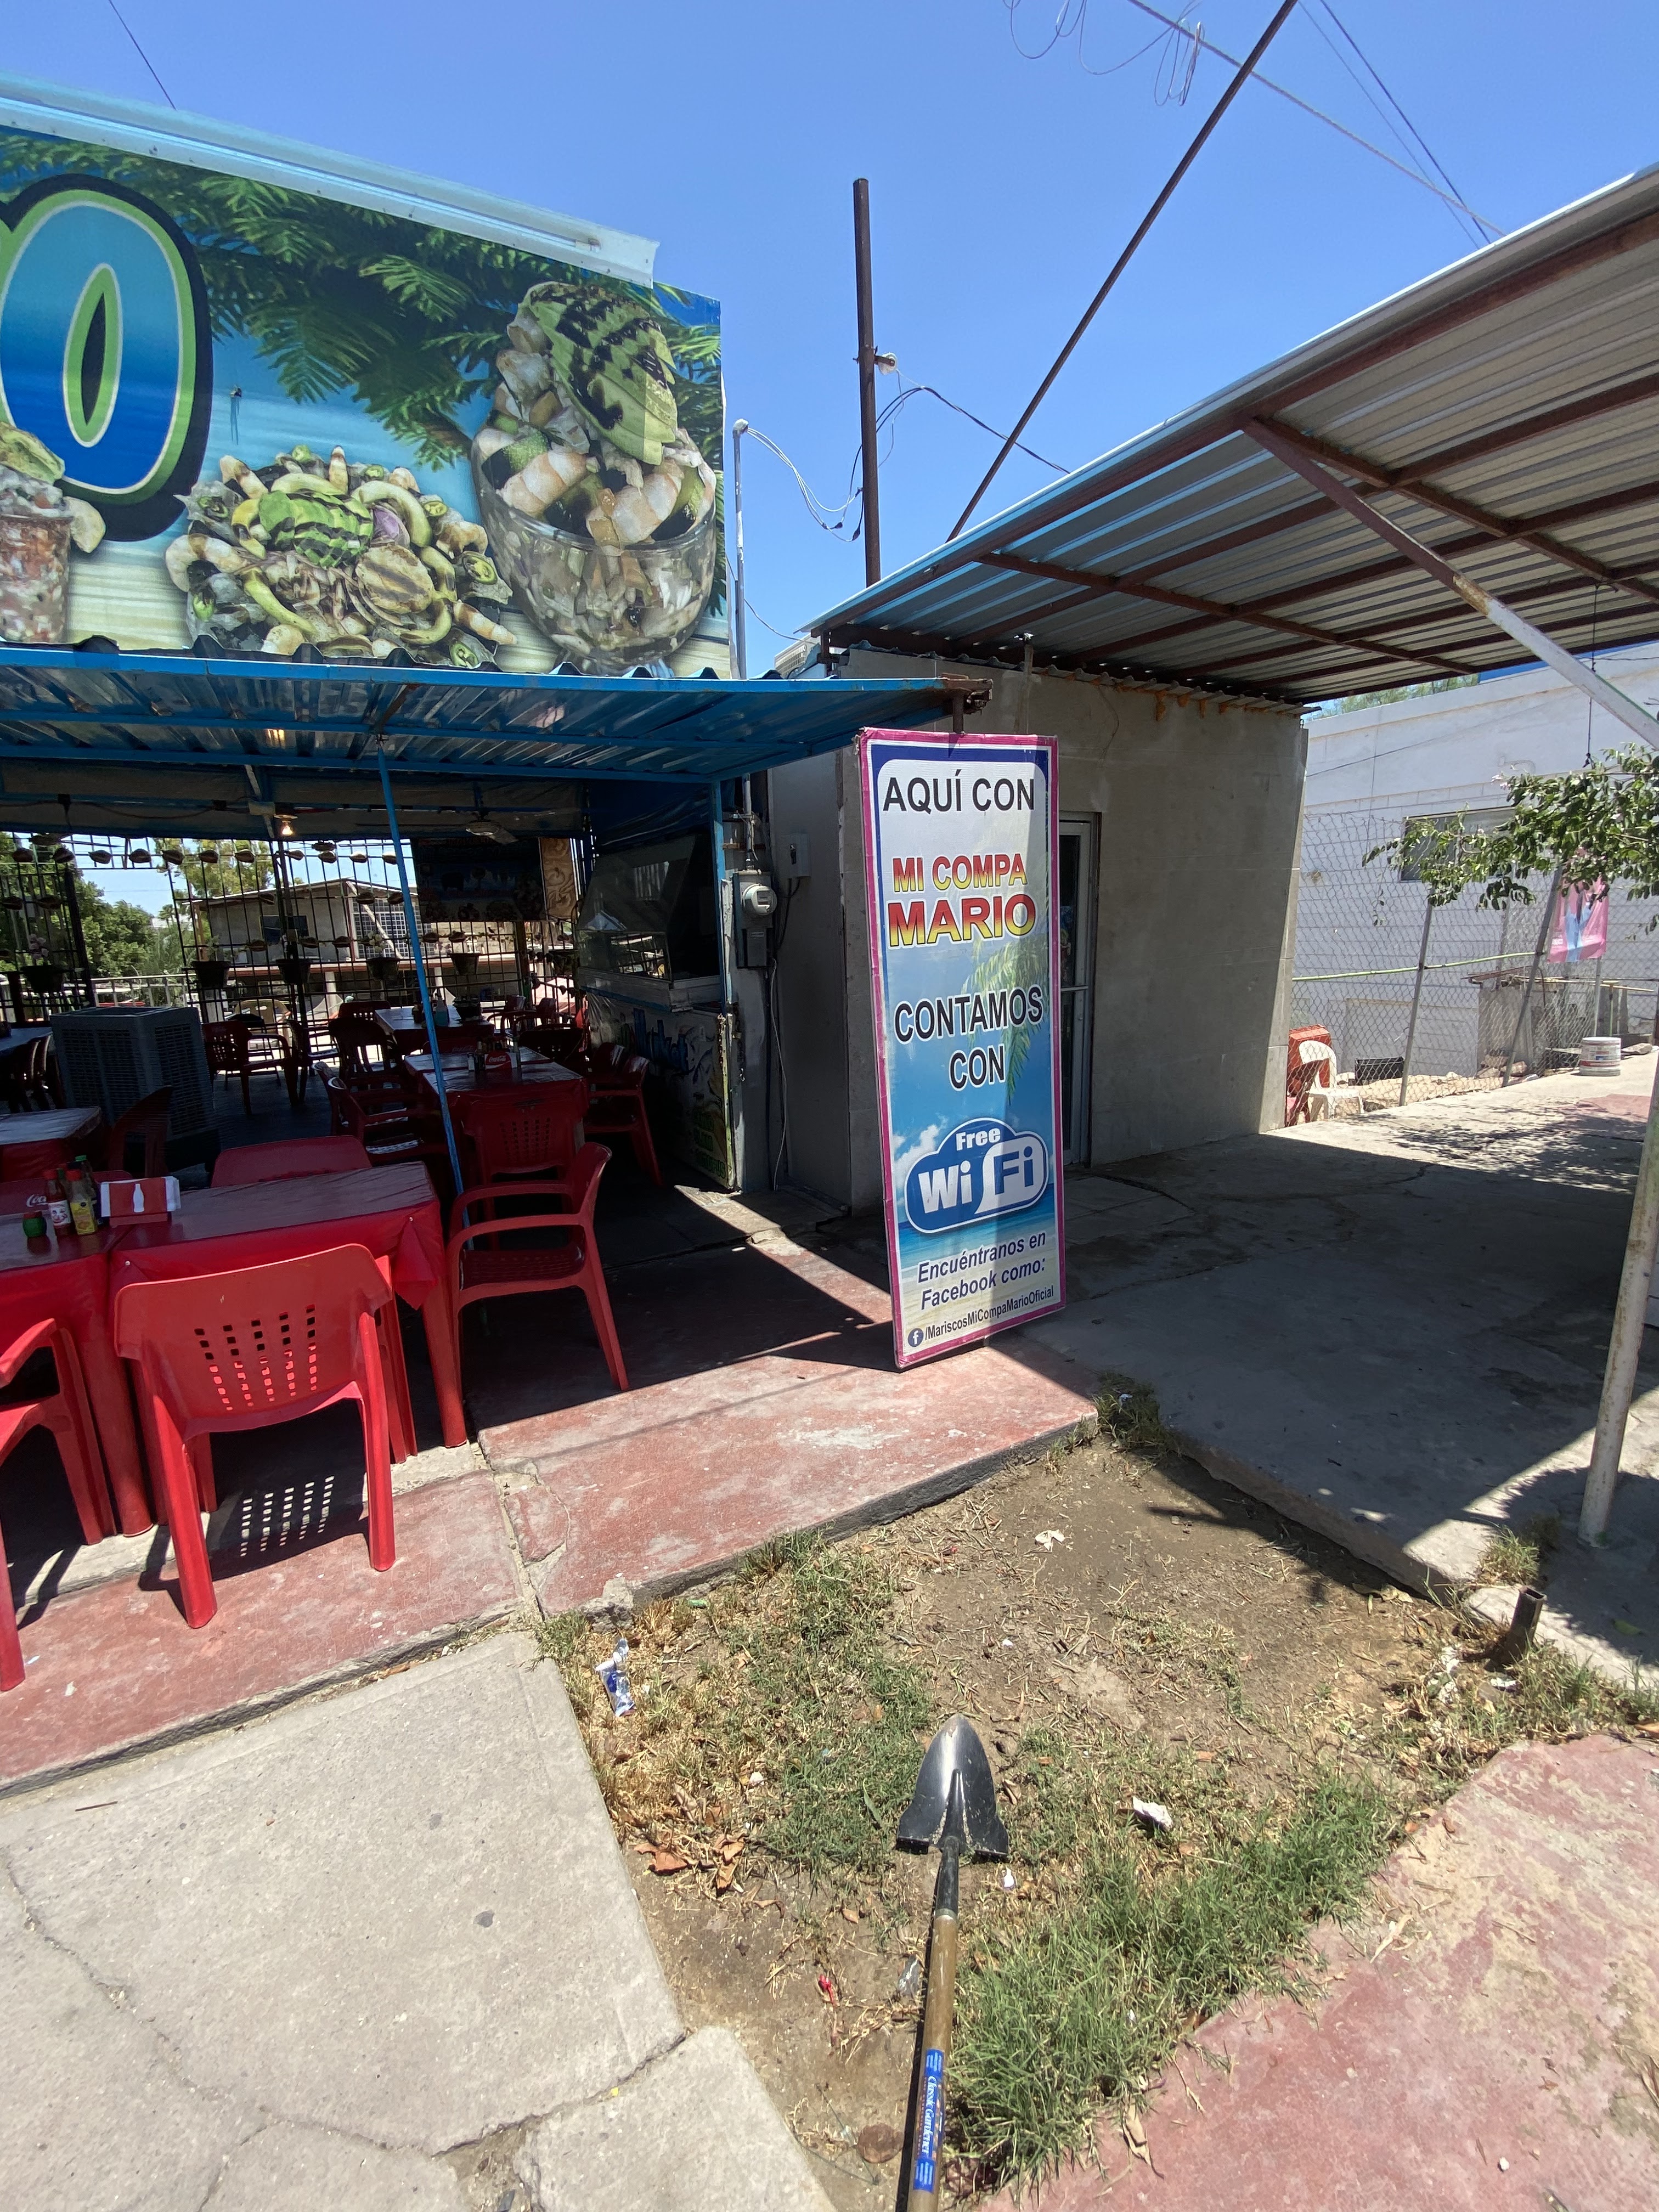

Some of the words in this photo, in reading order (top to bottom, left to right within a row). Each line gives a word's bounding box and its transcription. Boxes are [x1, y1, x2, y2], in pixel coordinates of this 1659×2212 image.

[883, 769, 962, 814] AQUÍ
[973, 778, 1035, 811] CON
[893, 857, 924, 893] MI
[932, 853, 1028, 890] COMPA
[888, 894, 1036, 947] MARIO
[895, 986, 1043, 1043] CONTAMOS
[950, 1045, 1004, 1090] CON
[956, 1127, 1001, 1151] Free
[918, 1239, 1024, 1283] Encuéntranos
[1029, 1232, 1046, 1249] en
[921, 1270, 997, 1310] Facebook
[1001, 1258, 1045, 1284] como:
[926, 2075, 937, 2109] Classic
